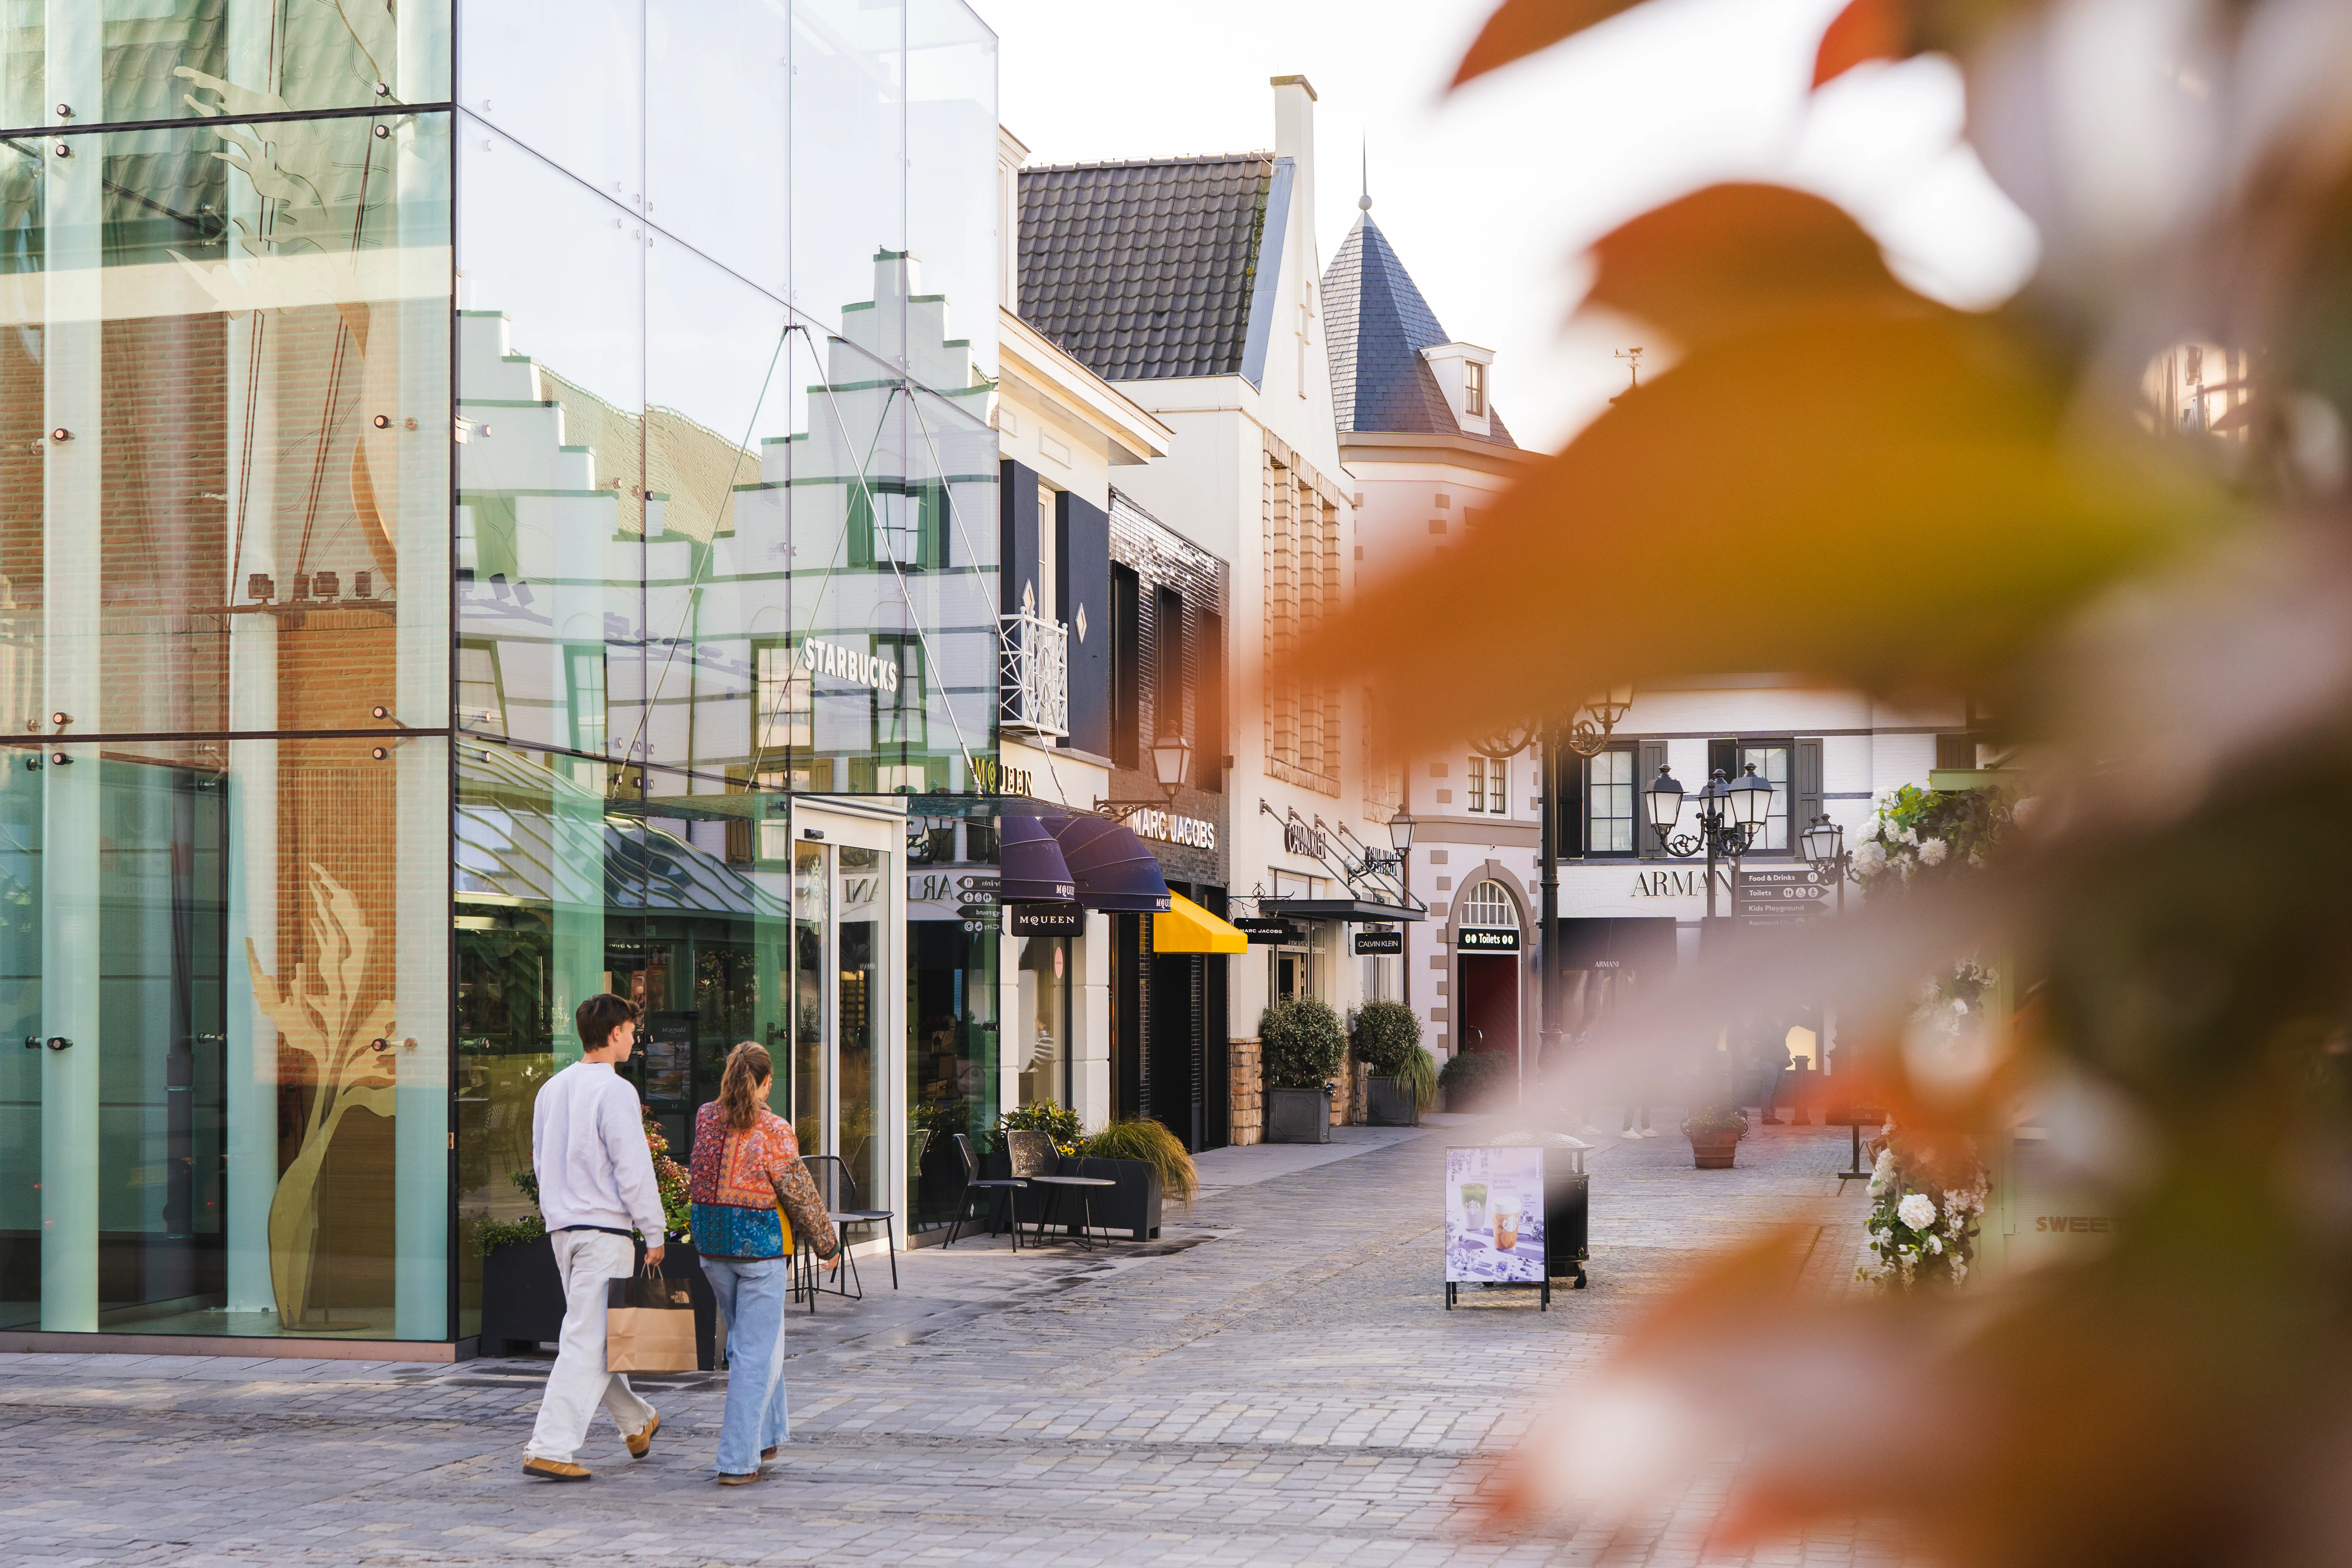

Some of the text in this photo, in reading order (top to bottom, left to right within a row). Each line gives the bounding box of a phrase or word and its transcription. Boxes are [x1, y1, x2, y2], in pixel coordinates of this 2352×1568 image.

[804, 637, 898, 693] STARBUCKS
[1132, 808, 1214, 850] MARC JACOBS
[1288, 823, 1327, 859] CALVIN KLEIN
[1631, 870, 1731, 897] ARMAN
[1479, 933, 1500, 944] Toilets
